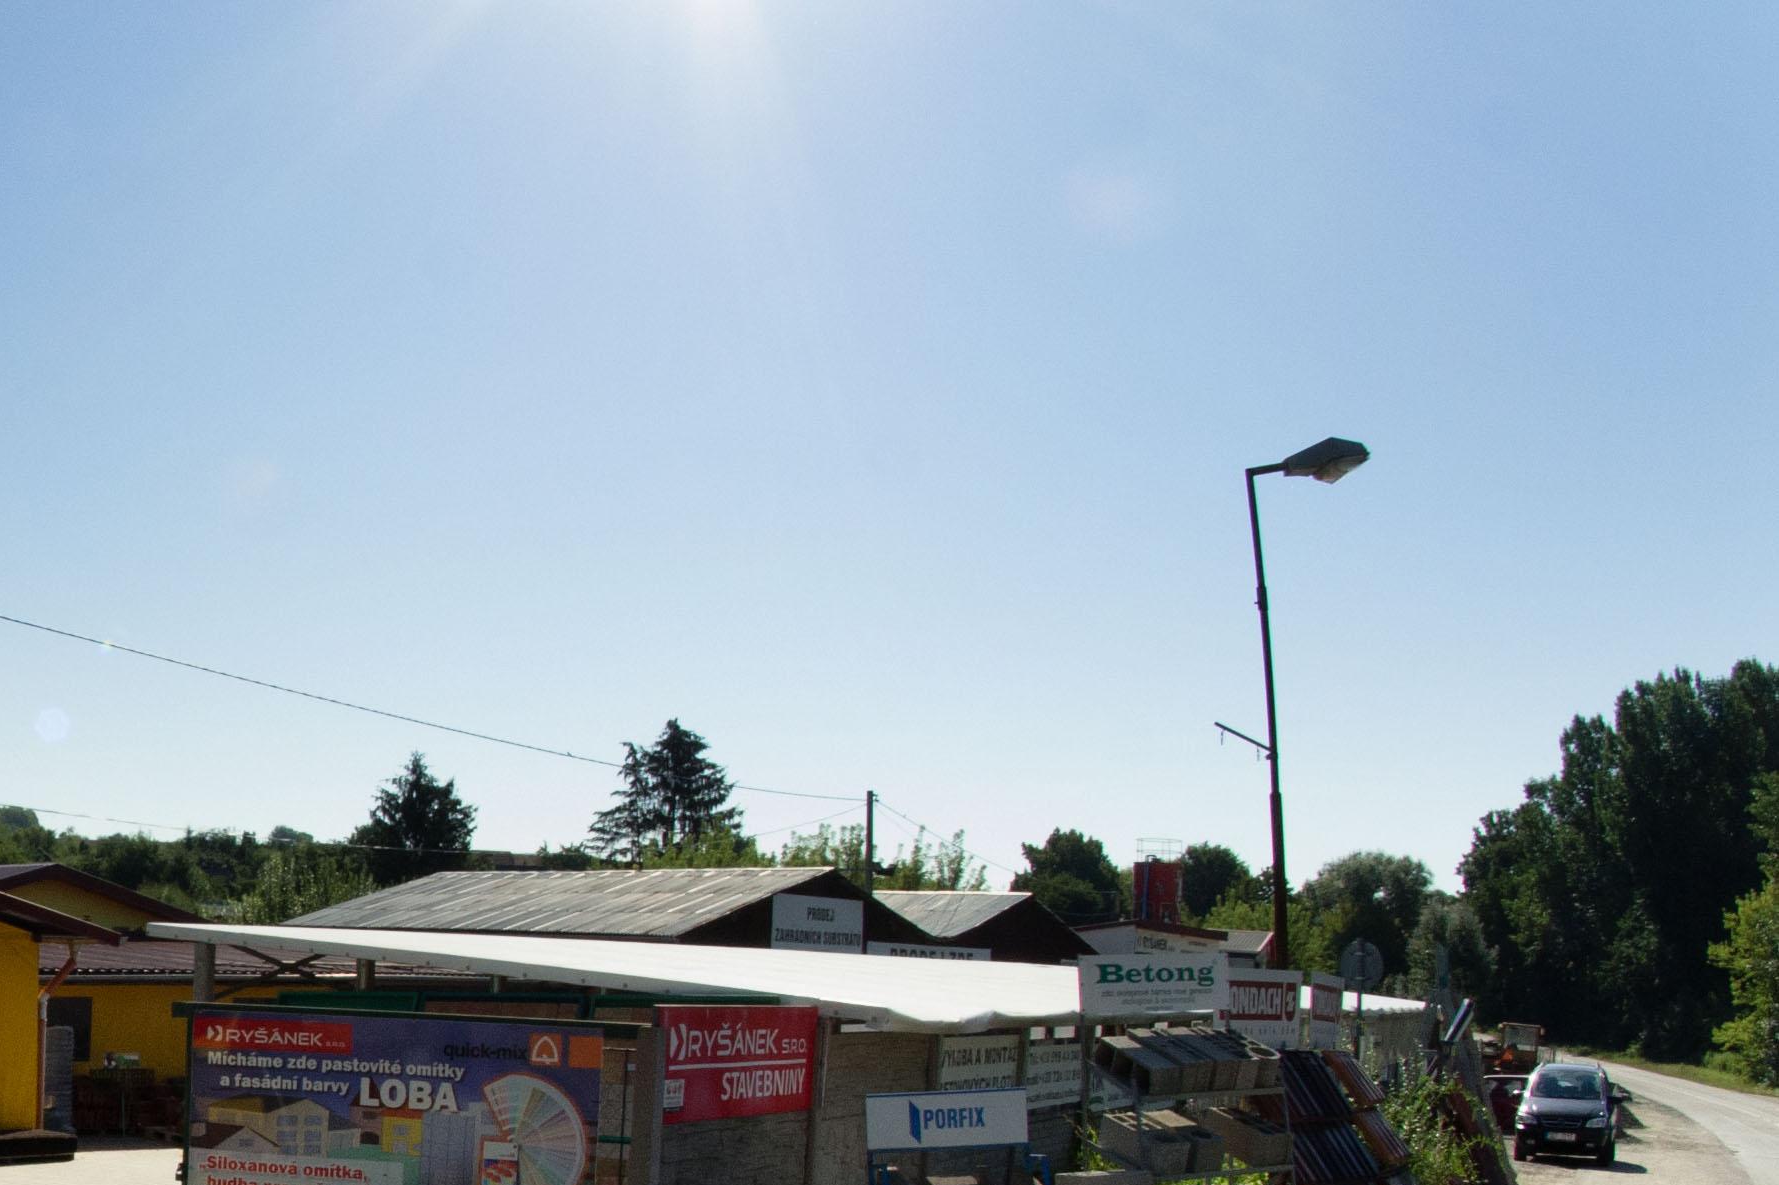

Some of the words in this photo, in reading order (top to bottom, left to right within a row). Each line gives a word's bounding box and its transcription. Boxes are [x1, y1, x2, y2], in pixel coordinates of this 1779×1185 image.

[1095, 963, 1215, 987] Betong
[1229, 986, 1283, 1015] ONDACH
[225, 1026, 323, 1047] RYŠÁNEK
[688, 1022, 780, 1058] RYŠÁNEK
[443, 1042, 527, 1061] quick-mix
[207, 1051, 283, 1069] Mícháme
[287, 1055, 317, 1071] zde
[405, 1062, 465, 1082] omítky
[220, 1076, 231, 1087] a
[234, 1073, 298, 1091] fasádní
[302, 1076, 350, 1096] barvy
[359, 1077, 459, 1113] LOBA
[720, 1068, 806, 1101] STAVEBNINY
[923, 1107, 986, 1130] PORFIX
